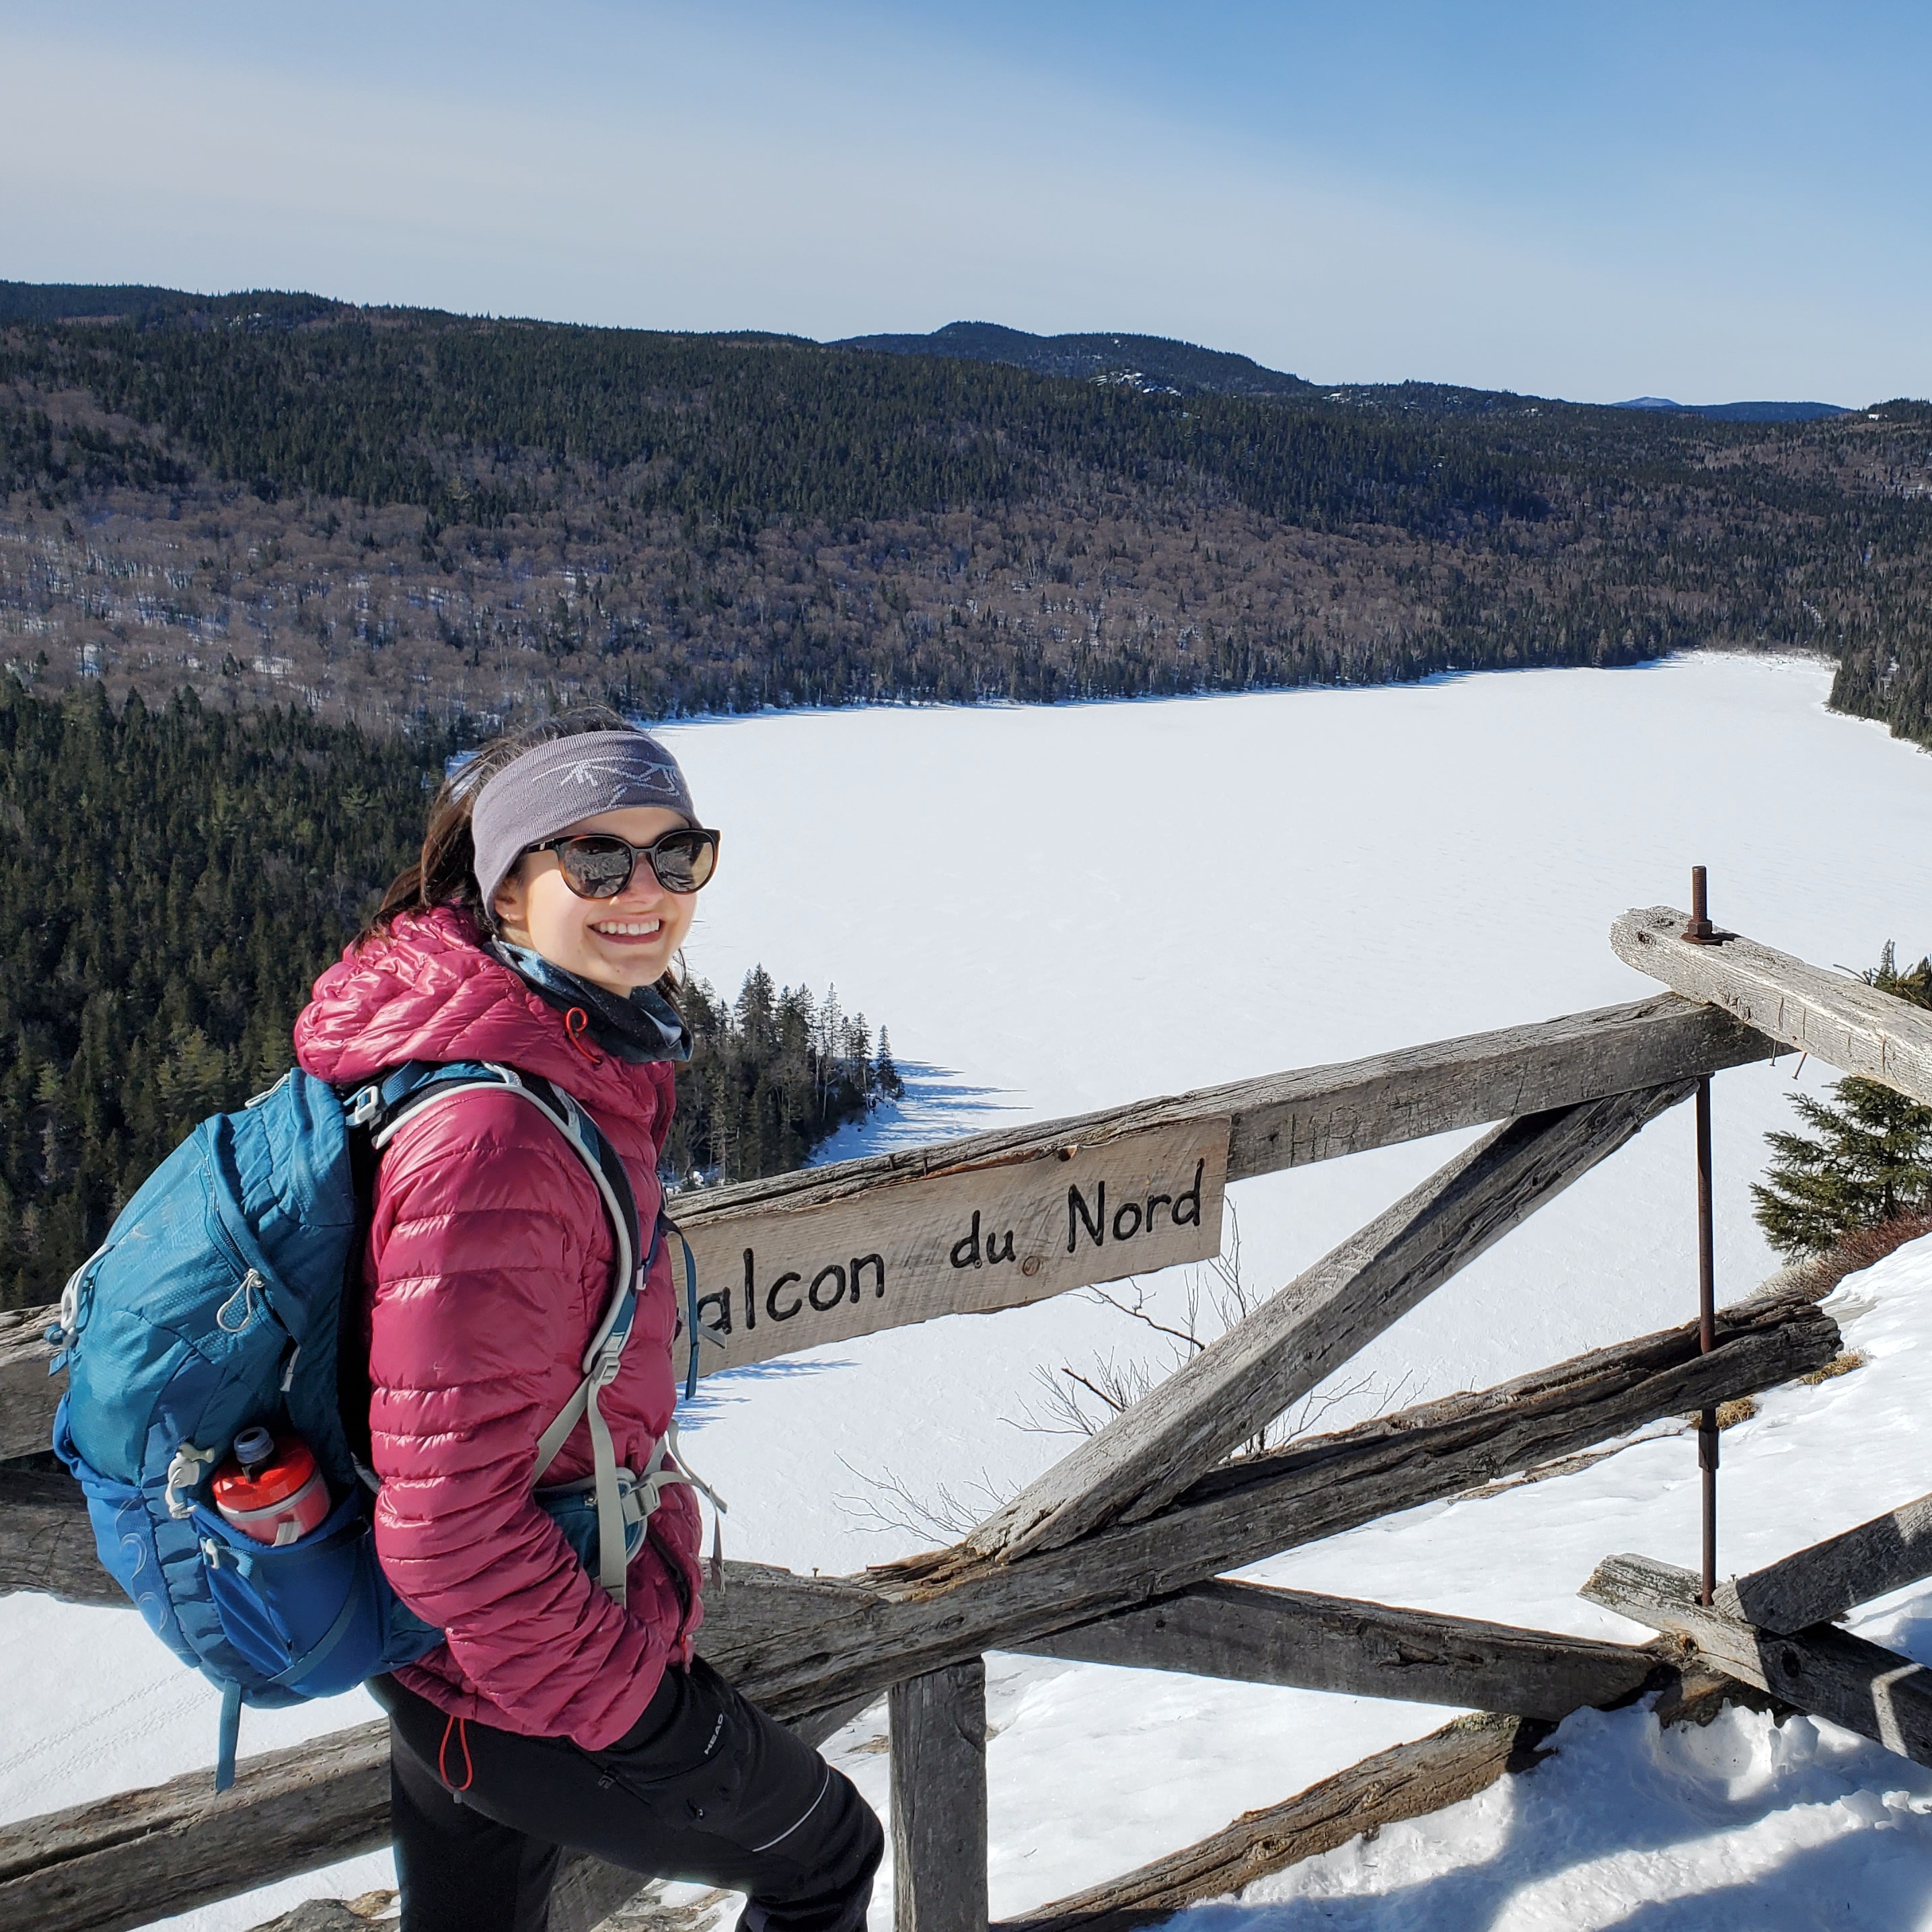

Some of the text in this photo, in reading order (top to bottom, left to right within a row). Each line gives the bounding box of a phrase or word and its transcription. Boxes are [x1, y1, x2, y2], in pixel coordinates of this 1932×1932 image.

[673, 1158, 1205, 1343] alcon du Nord
[704, 1713, 723, 1755] HEAD
